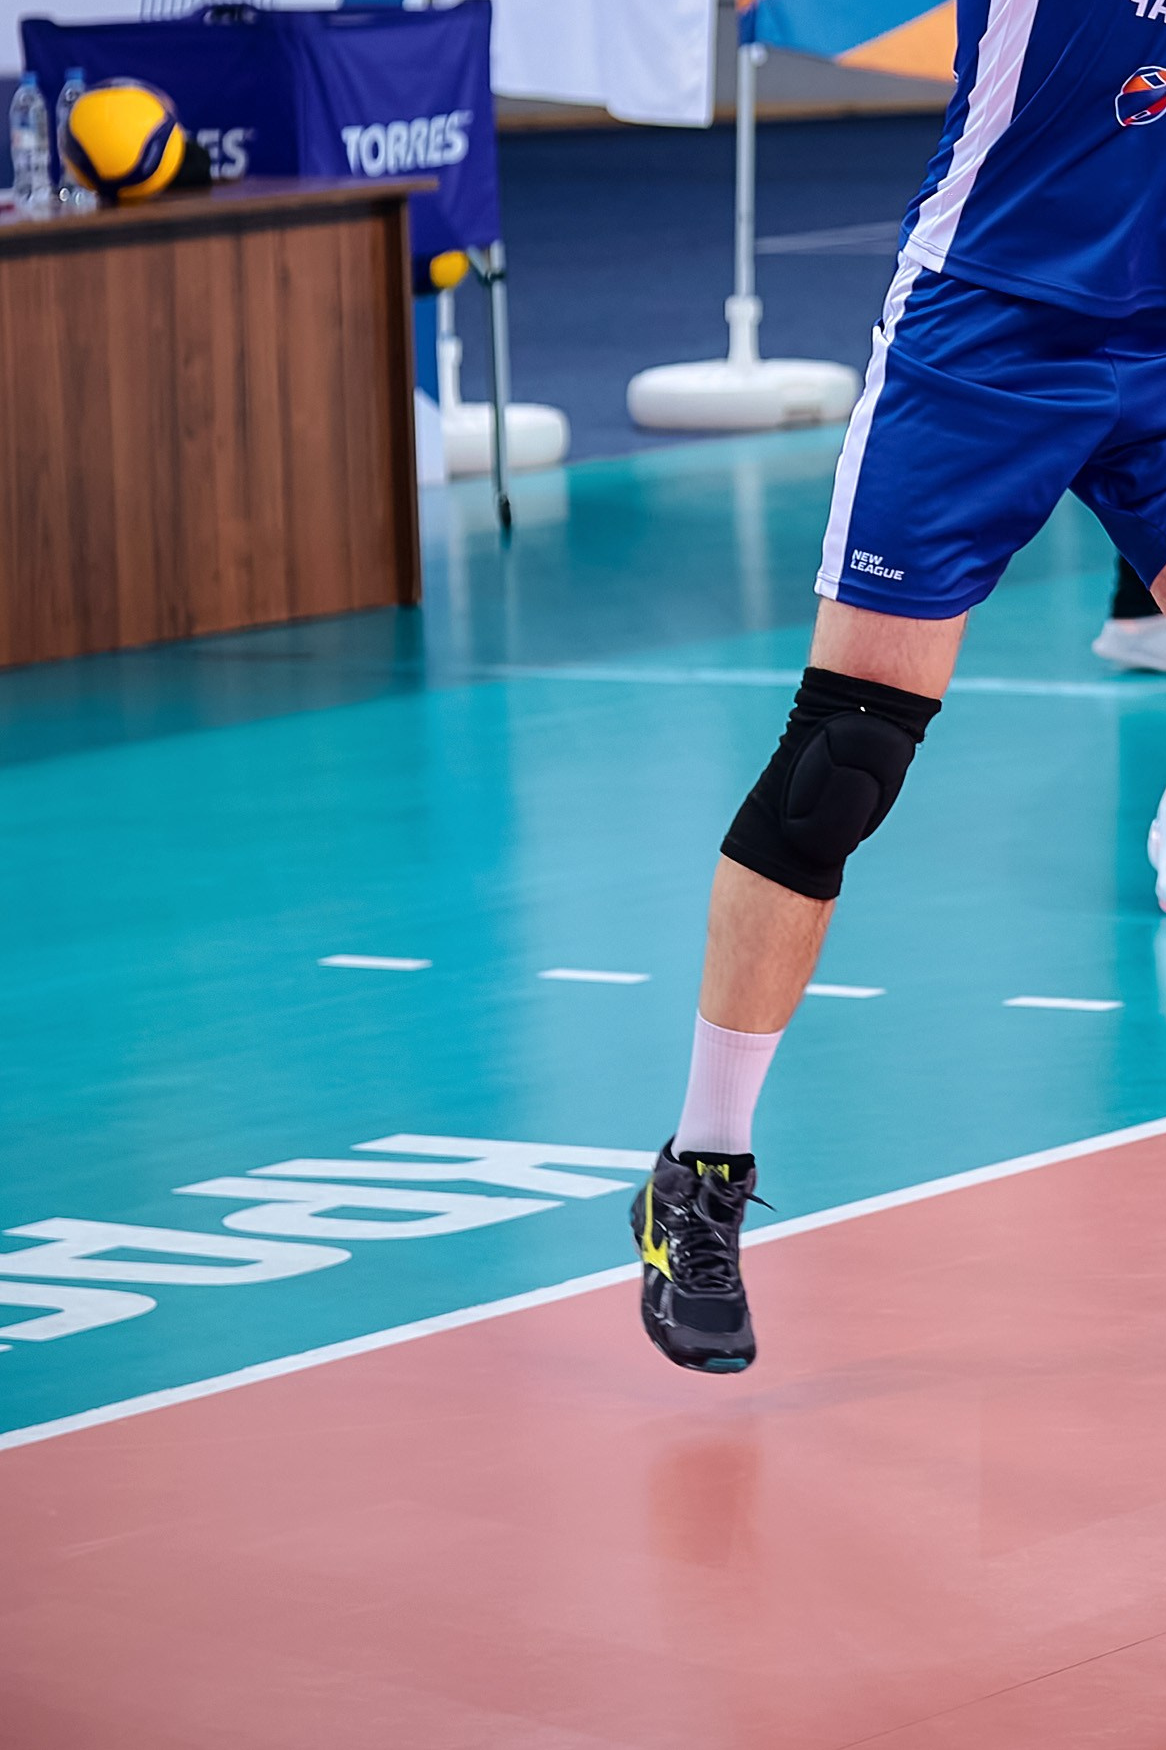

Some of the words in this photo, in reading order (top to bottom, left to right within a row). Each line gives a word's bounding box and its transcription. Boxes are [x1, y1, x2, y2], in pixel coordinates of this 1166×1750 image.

[341, 111, 473, 178] TORRES
[852, 549, 883, 565] NEW
[850, 560, 904, 581] LEAGUE
